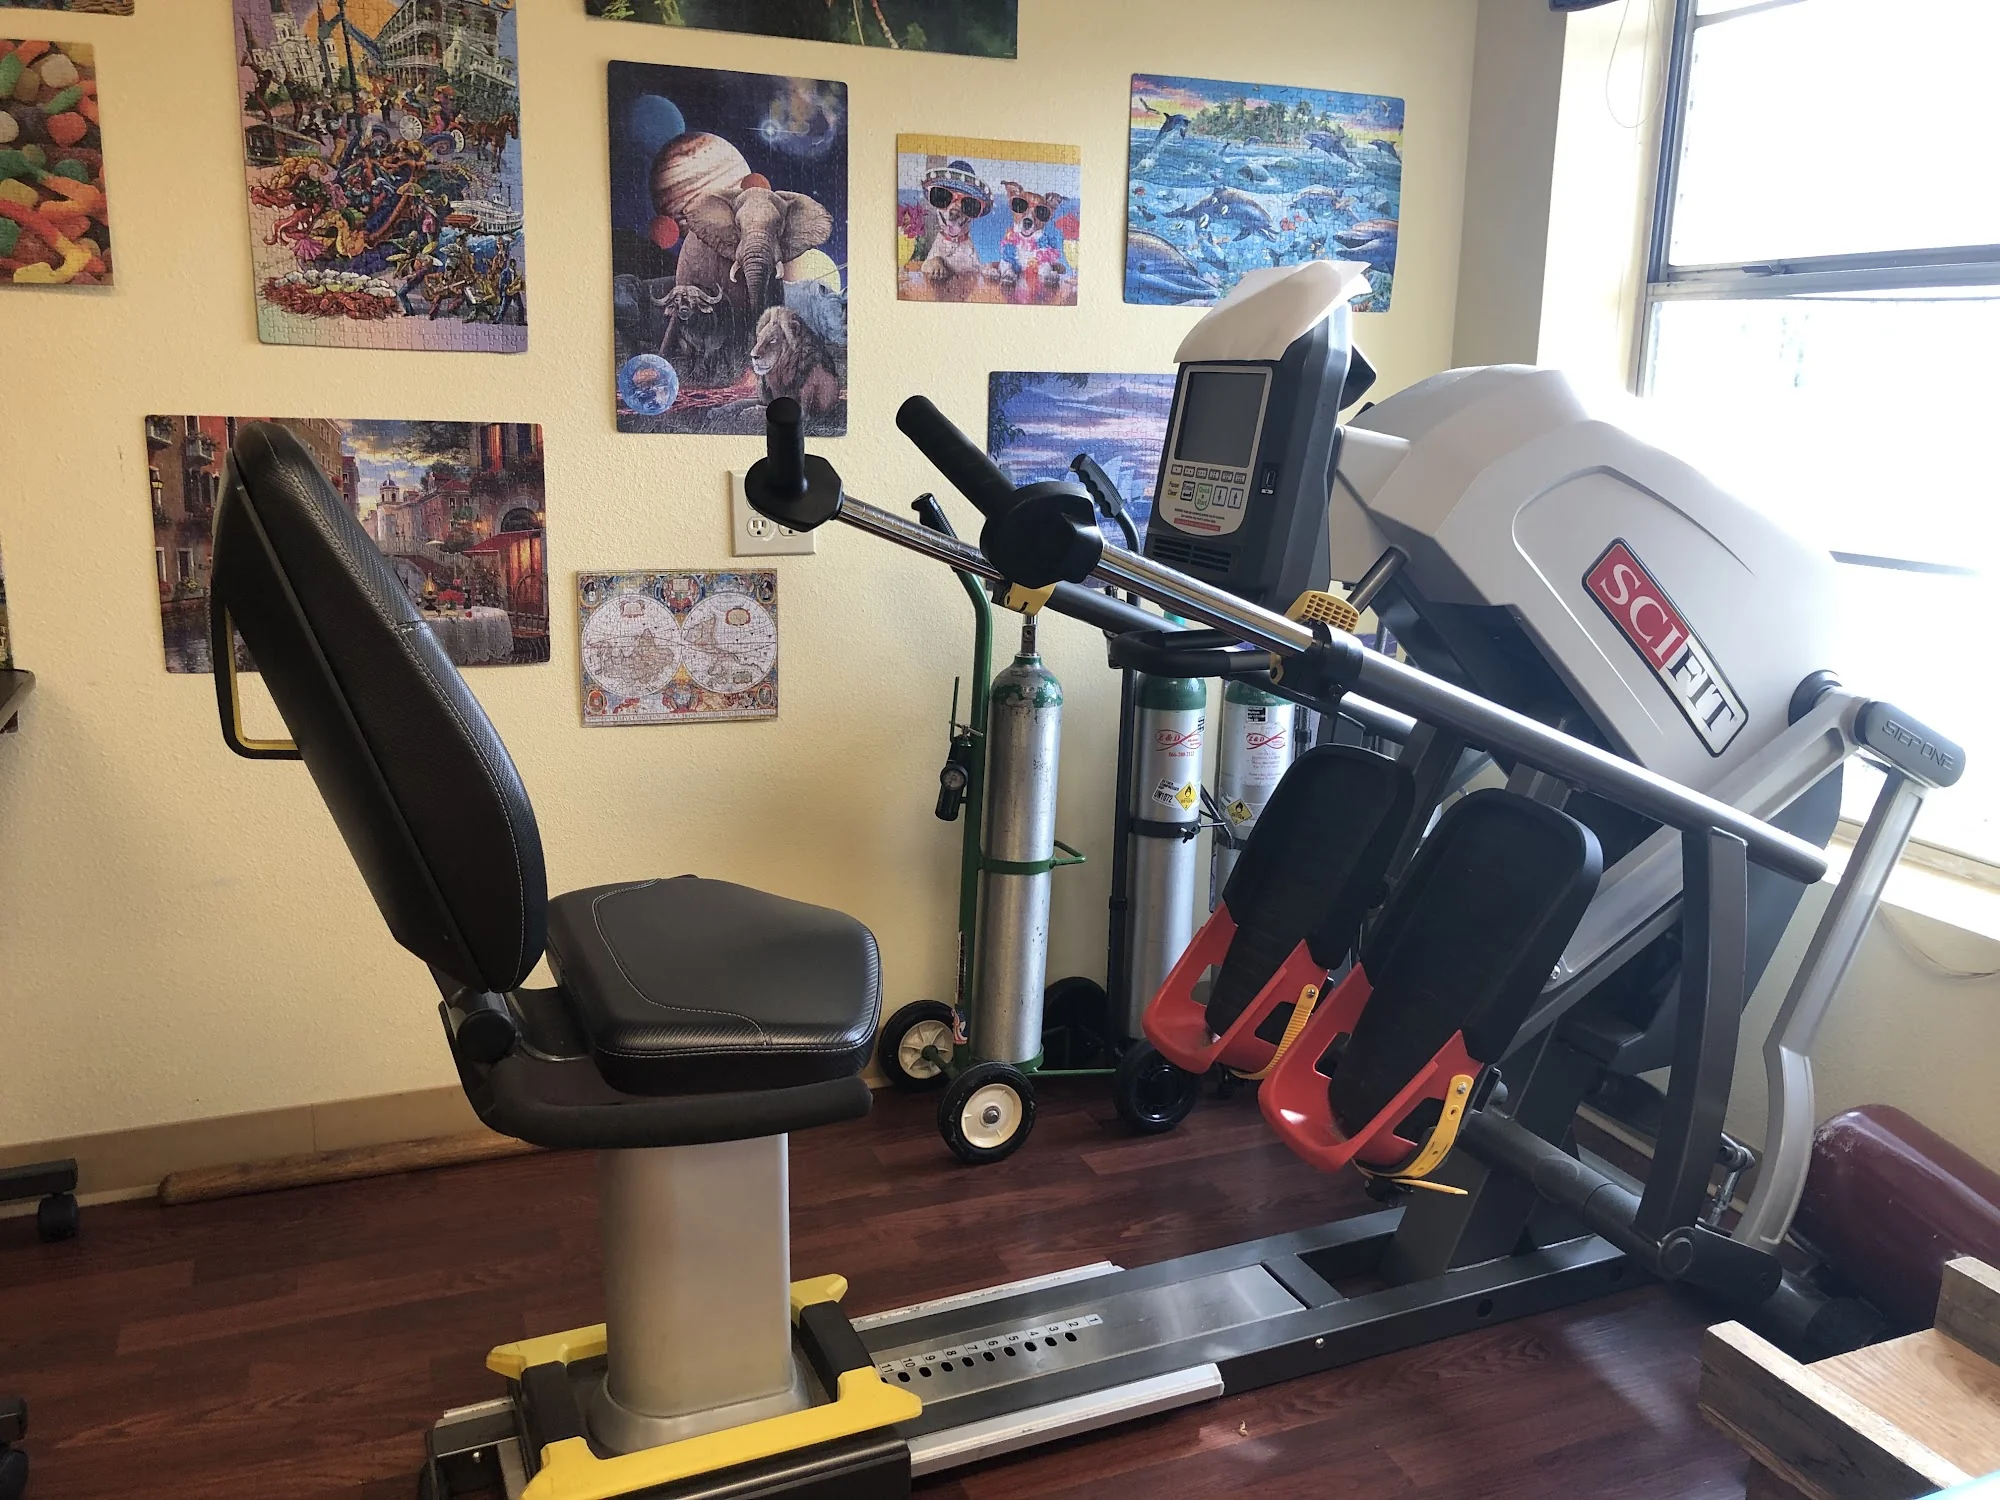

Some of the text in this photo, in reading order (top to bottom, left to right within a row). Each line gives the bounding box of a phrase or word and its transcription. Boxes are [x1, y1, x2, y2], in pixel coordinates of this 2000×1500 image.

[1199, 486, 1210, 494] Quick
[1196, 499, 1207, 507] Start
[1600, 563, 1735, 732] SCIFIT
[1881, 719, 1954, 771] STEP ONE
[1154, 789, 1173, 803] UN1072
[881, 1363, 895, 1374] 11
[903, 1358, 916, 1369] 10
